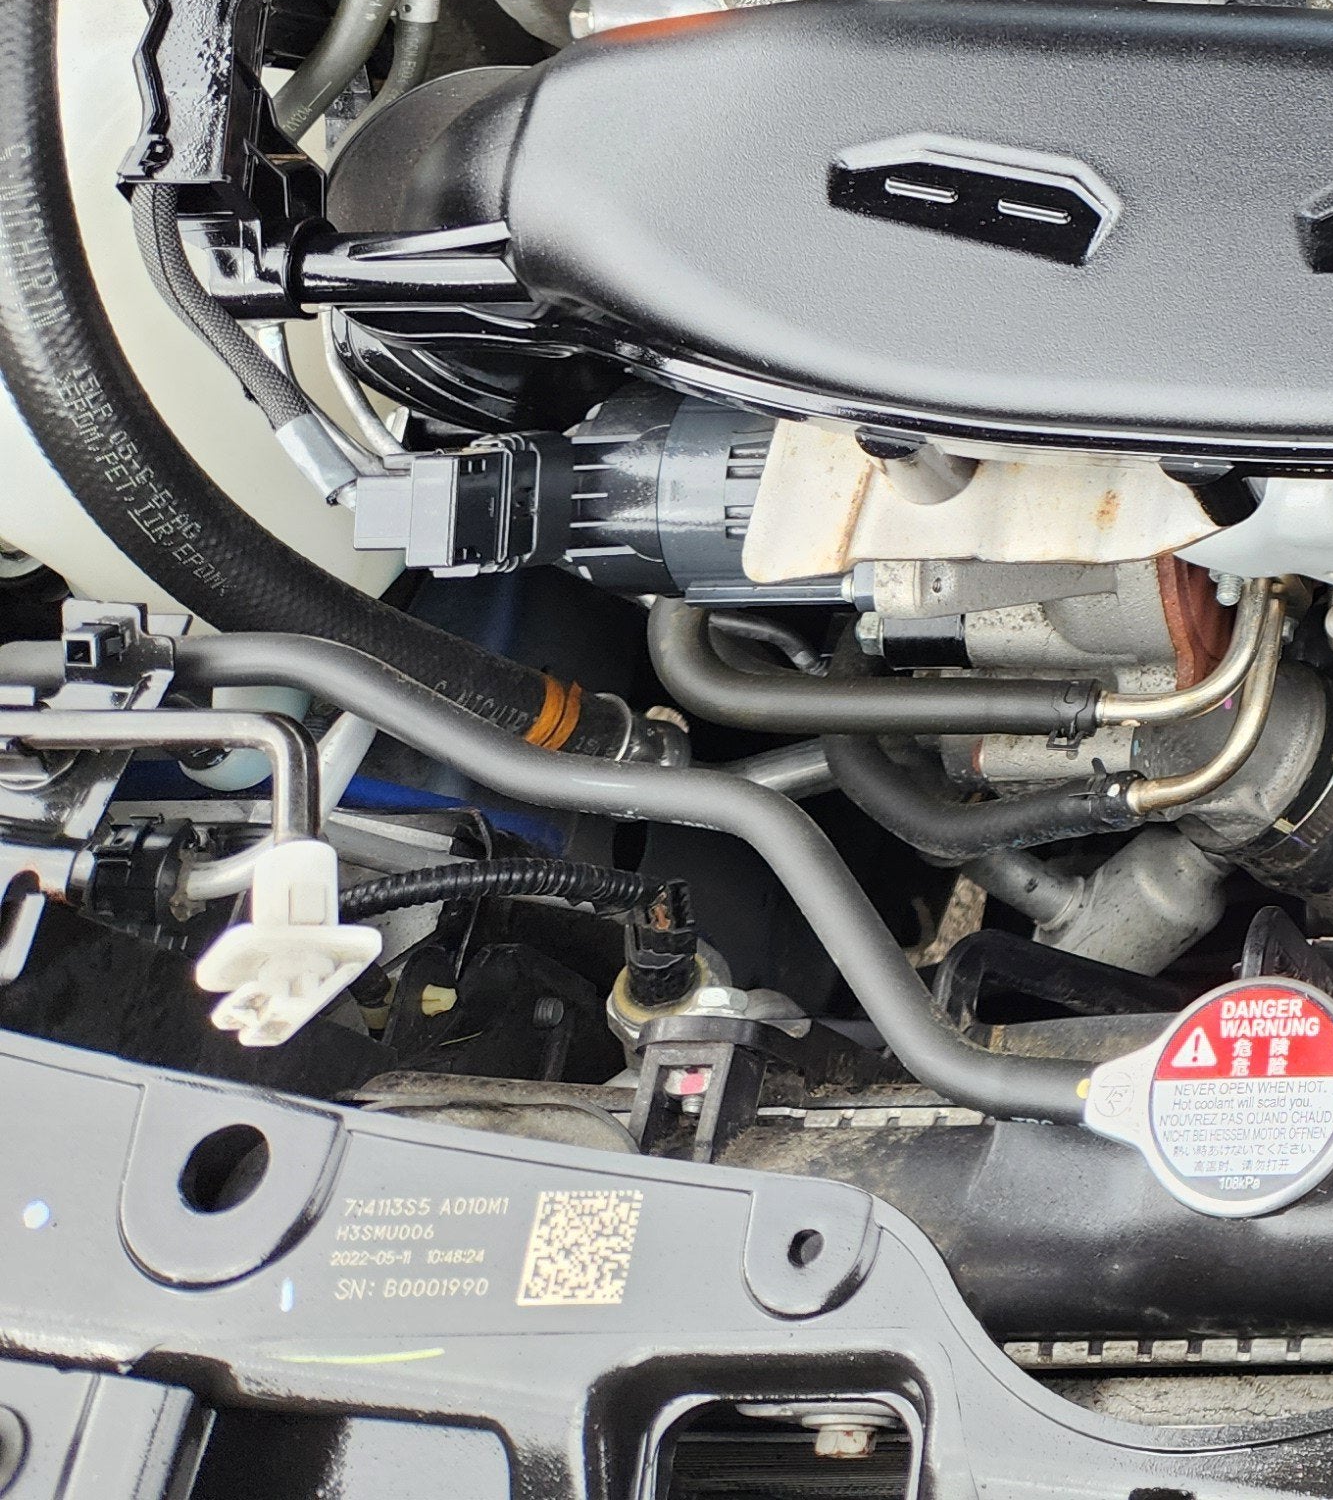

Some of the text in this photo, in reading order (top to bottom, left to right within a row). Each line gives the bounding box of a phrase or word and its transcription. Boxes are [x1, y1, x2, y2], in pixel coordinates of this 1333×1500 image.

[1220, 999, 1303, 1019] DANGER
[1220, 1016, 1321, 1038] WARNUNG
[1174, 1080, 1328, 1097] NEVER OPEN WHEN HOT.
[1172, 1099, 1192, 1112] Hot
[1194, 1097, 1234, 1110] coolant
[1237, 1097, 1254, 1109] will
[1257, 1096, 1287, 1108] scald
[1159, 1112, 1217, 1127] N'OUVREZ
[1220, 1112, 1243, 1125] PAS
[1247, 1112, 1289, 1125] QUAND
[1163, 1130, 1190, 1143] NICHT
[1192, 1129, 1207, 1142] BEI
[1210, 1128, 1249, 1142] HEISSEM
[1252, 1127, 1286, 1140] MOTOR
[1218, 1176, 1261, 1191] 108kPa
[439, 1196, 509, 1217] A010M1
[336, 1223, 435, 1242] H3SMU006
[330, 1248, 485, 1266] 2022-05-11 10:48:24
[334, 1277, 489, 1300] SN: B0001990
